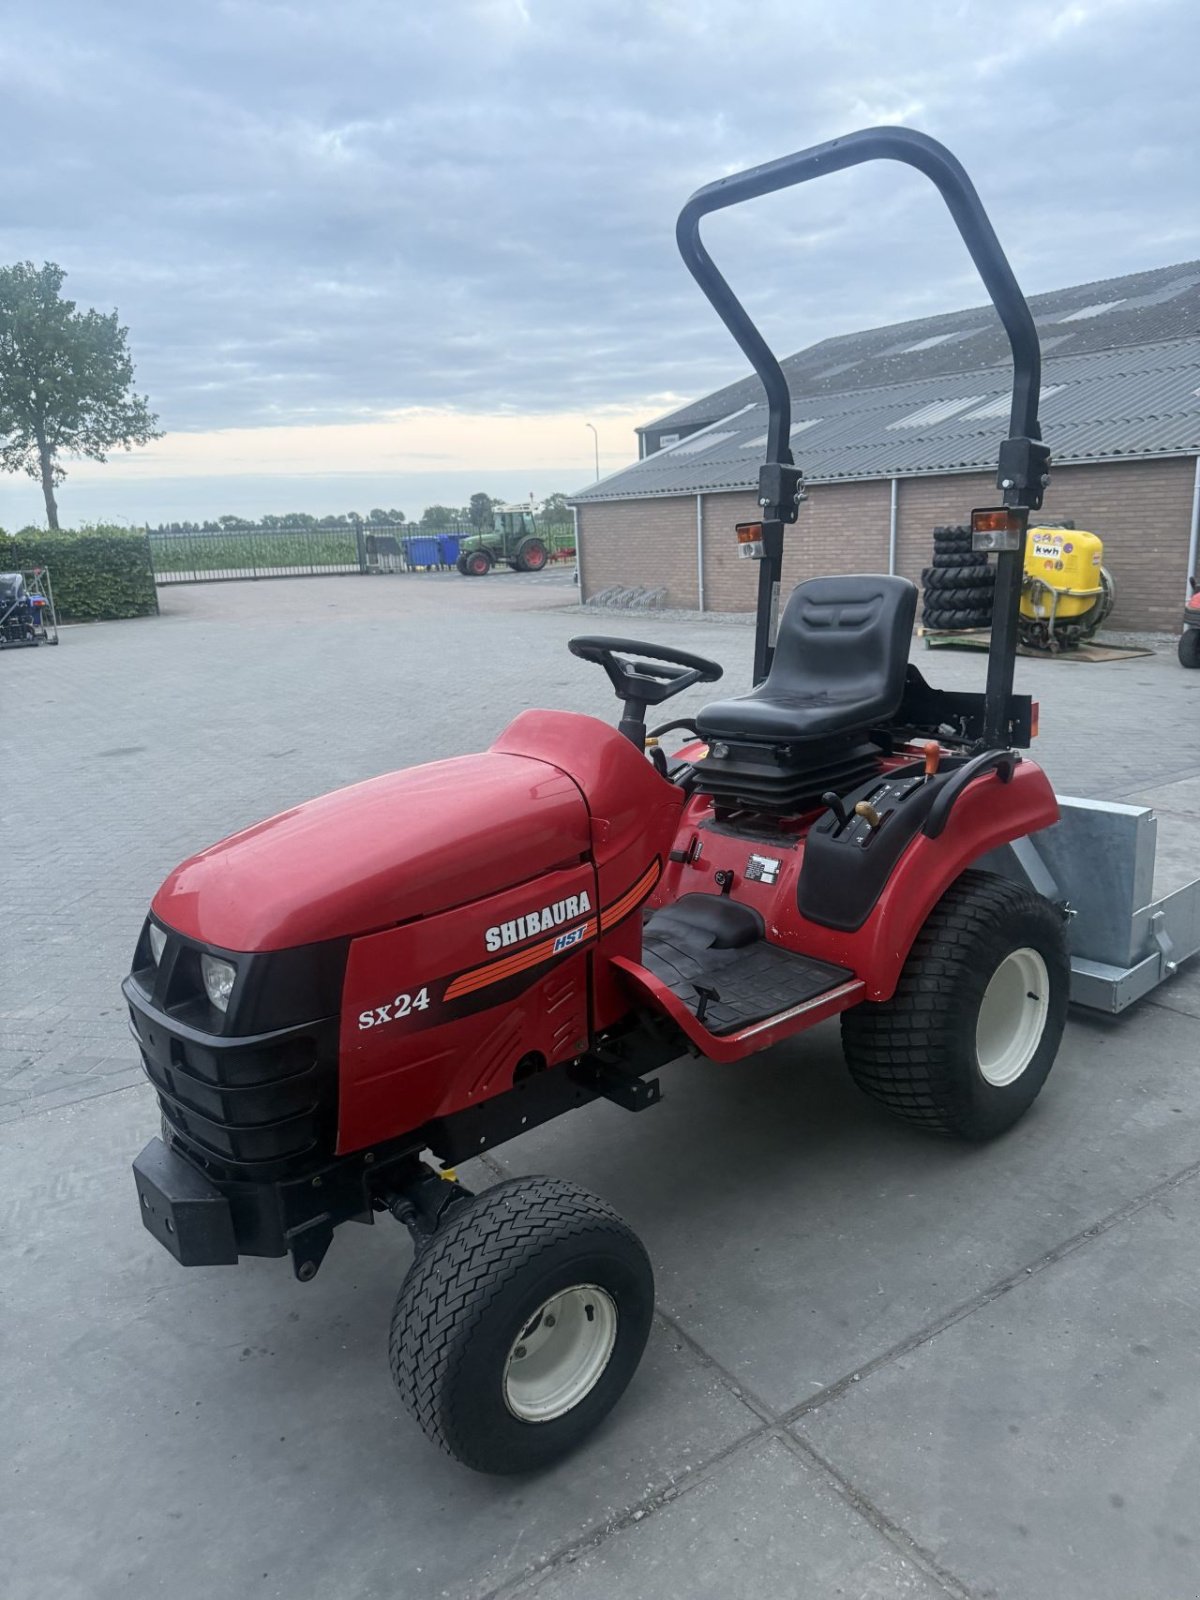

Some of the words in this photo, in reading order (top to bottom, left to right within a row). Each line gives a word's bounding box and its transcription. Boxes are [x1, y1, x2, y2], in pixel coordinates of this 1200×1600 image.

[485, 891, 591, 952] SHIBAURA
[554, 925, 587, 952] HST
[358, 987, 431, 1030] SX24
